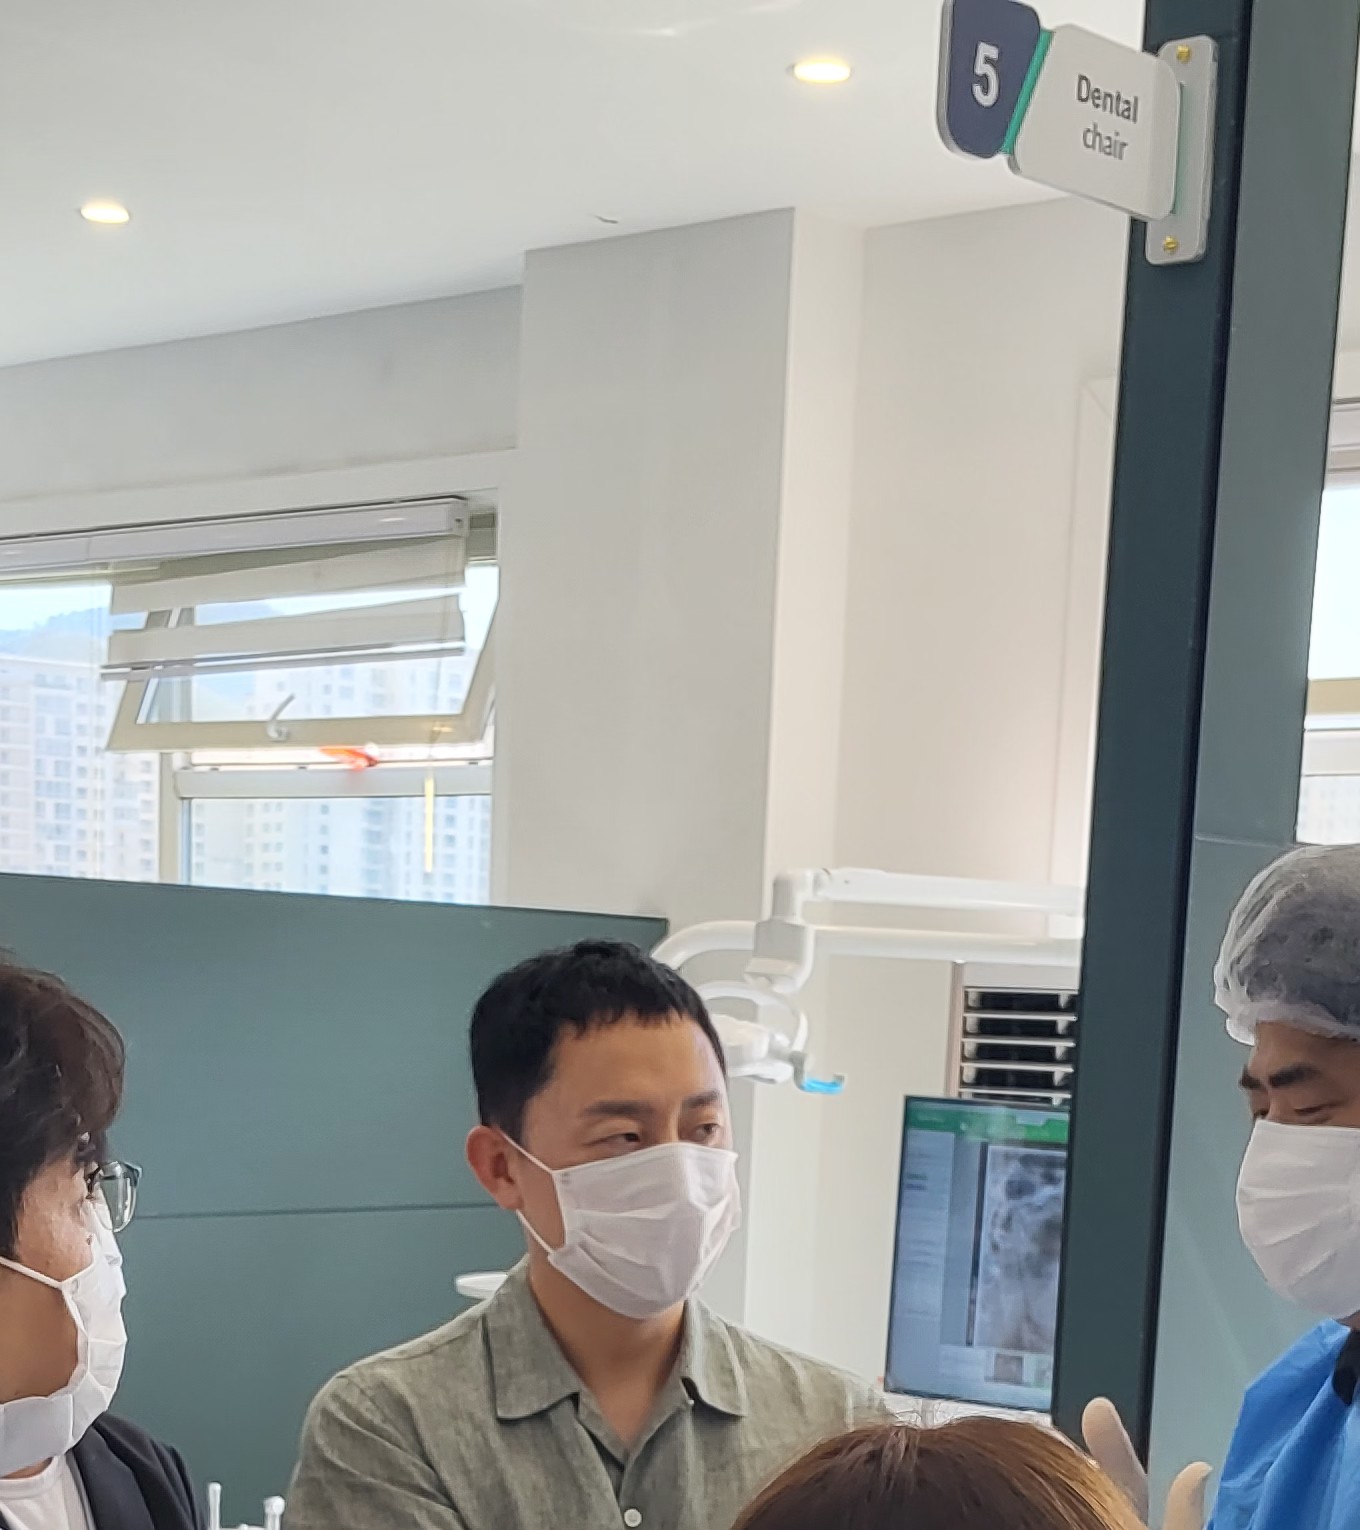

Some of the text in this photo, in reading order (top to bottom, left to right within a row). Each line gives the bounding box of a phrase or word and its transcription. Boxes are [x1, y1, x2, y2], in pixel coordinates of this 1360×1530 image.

[971, 42, 999, 107] 5
[1076, 74, 1138, 124] Dental
[1082, 124, 1128, 160] chair
